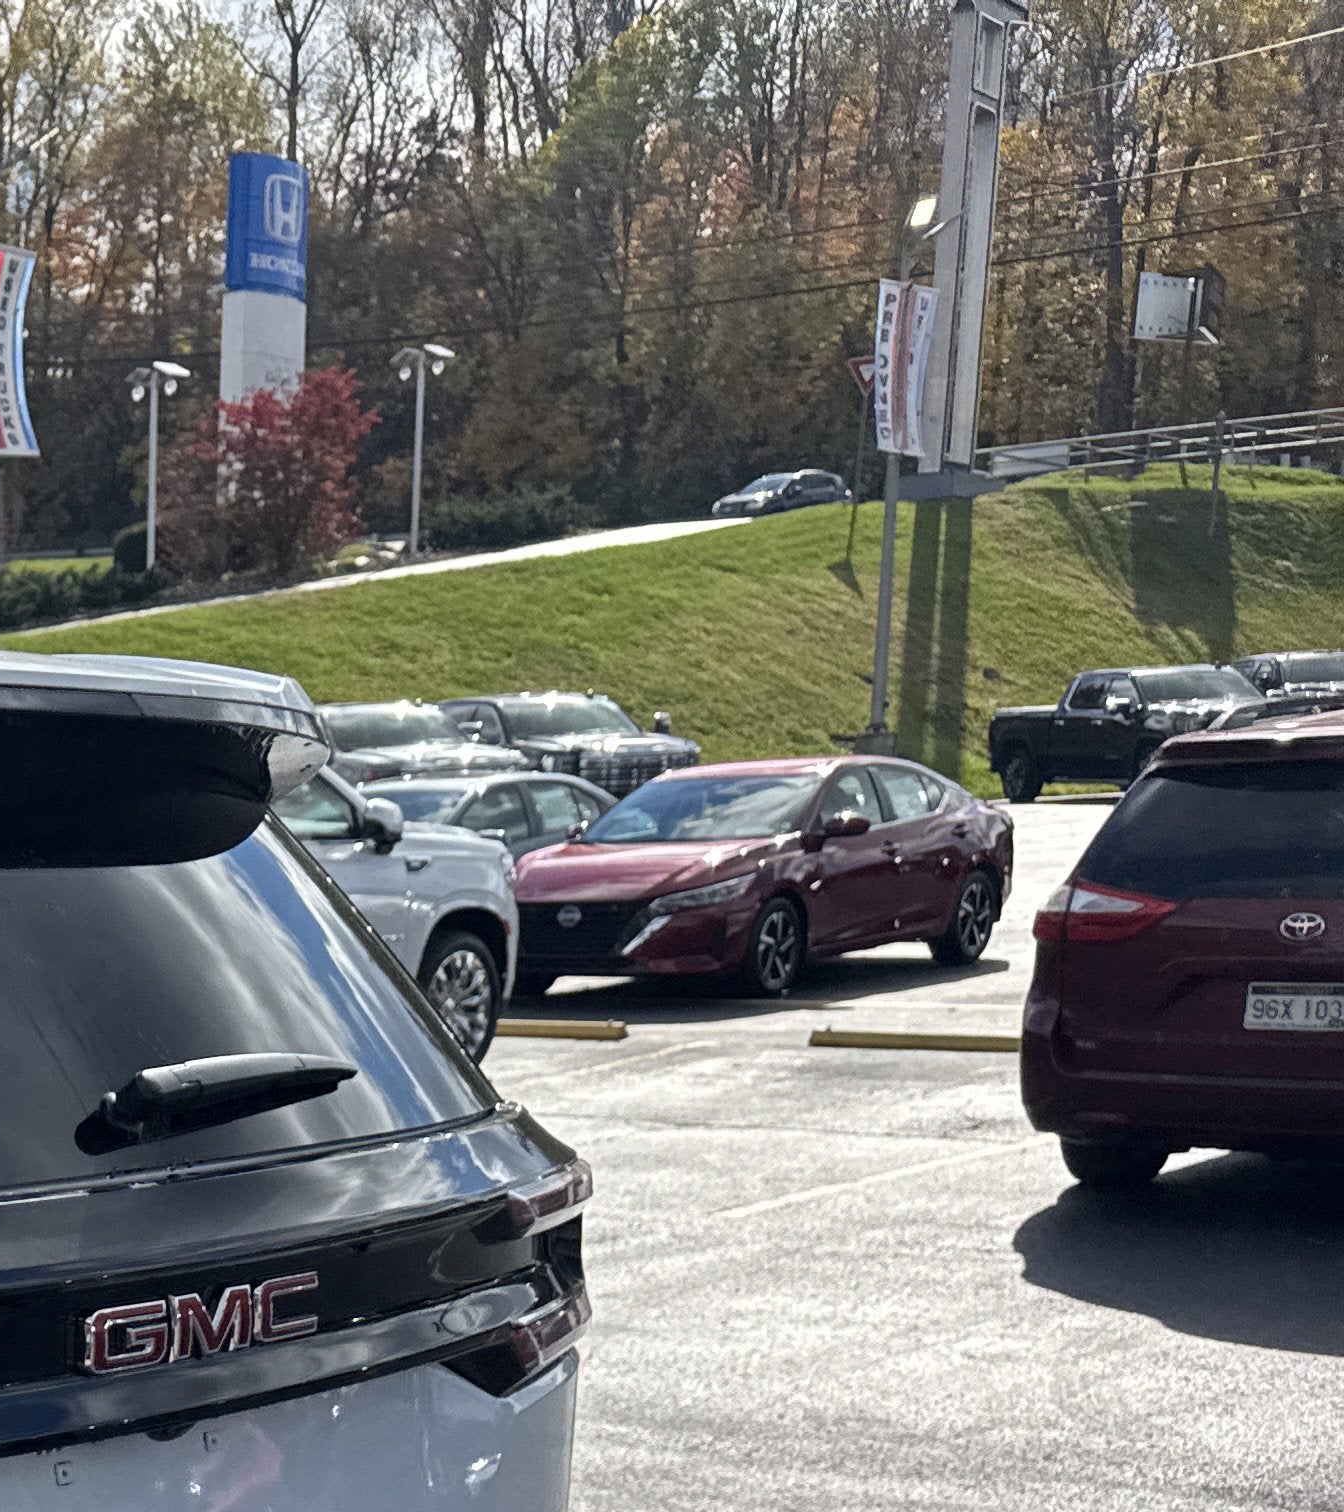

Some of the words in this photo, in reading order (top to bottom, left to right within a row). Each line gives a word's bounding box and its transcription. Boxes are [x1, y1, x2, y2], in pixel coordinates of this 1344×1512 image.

[1252, 998, 1294, 1020] 96X
[1303, 999, 1342, 1021] 103
[85, 1270, 319, 1375] GMC
